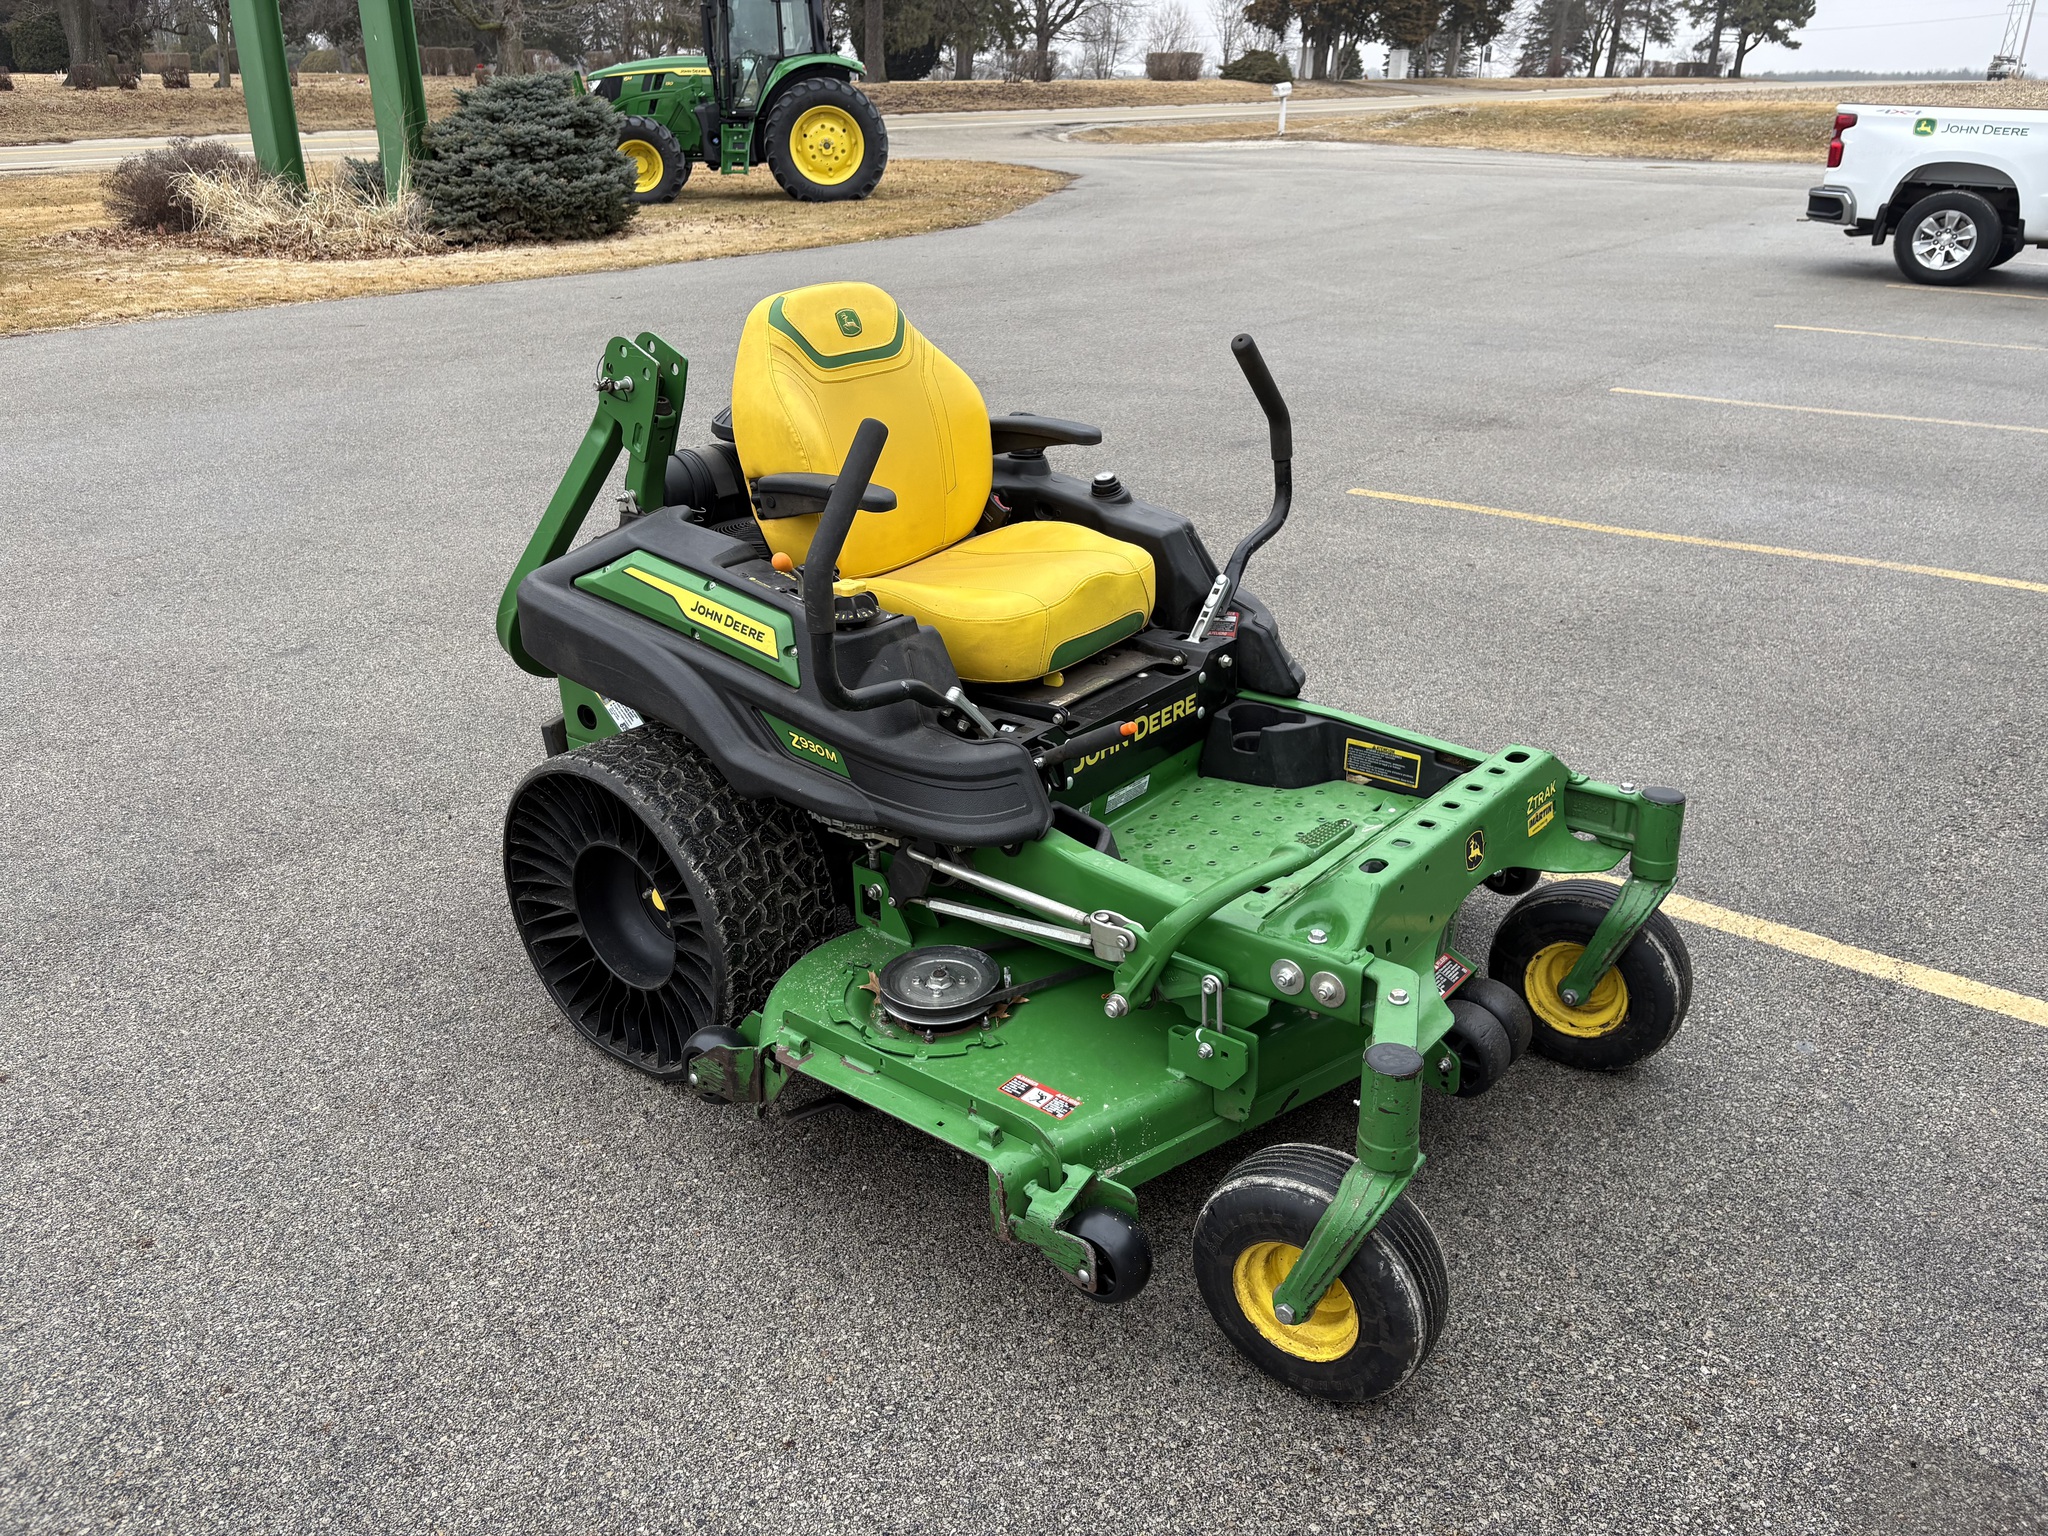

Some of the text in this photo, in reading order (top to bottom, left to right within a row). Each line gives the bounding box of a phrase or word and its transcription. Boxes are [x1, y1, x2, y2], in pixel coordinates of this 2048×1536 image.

[1941, 123, 2030, 137] JOHN DEERE
[690, 600, 765, 643] JOHN DEERE
[1134, 693, 1197, 742] DEERE
[788, 731, 838, 763] Z930M
[1526, 780, 1557, 815] ZTRAK
